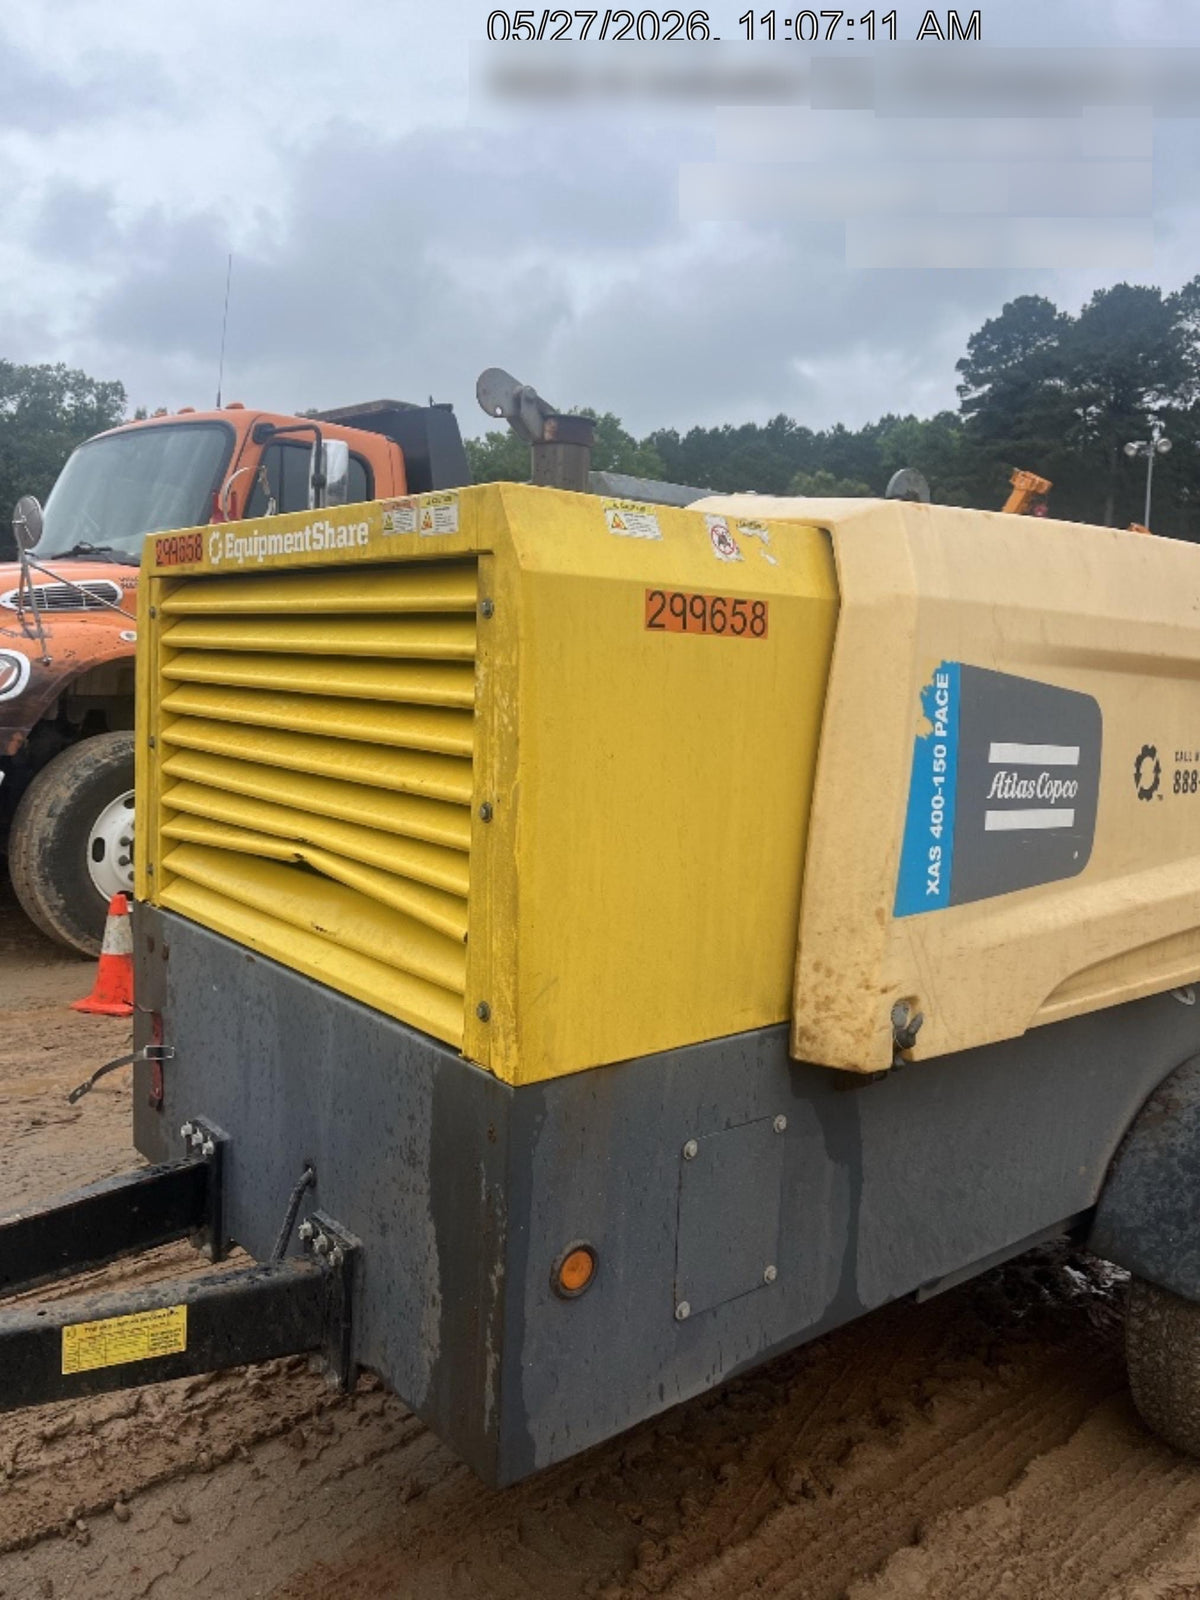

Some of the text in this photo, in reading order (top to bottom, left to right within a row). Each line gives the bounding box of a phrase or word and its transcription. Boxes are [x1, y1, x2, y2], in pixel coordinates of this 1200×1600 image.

[155, 533, 204, 567] 299658
[224, 521, 369, 564] EquipmentShare
[646, 589, 766, 637] 299658
[926, 673, 949, 895] XAS 400-150 PACE
